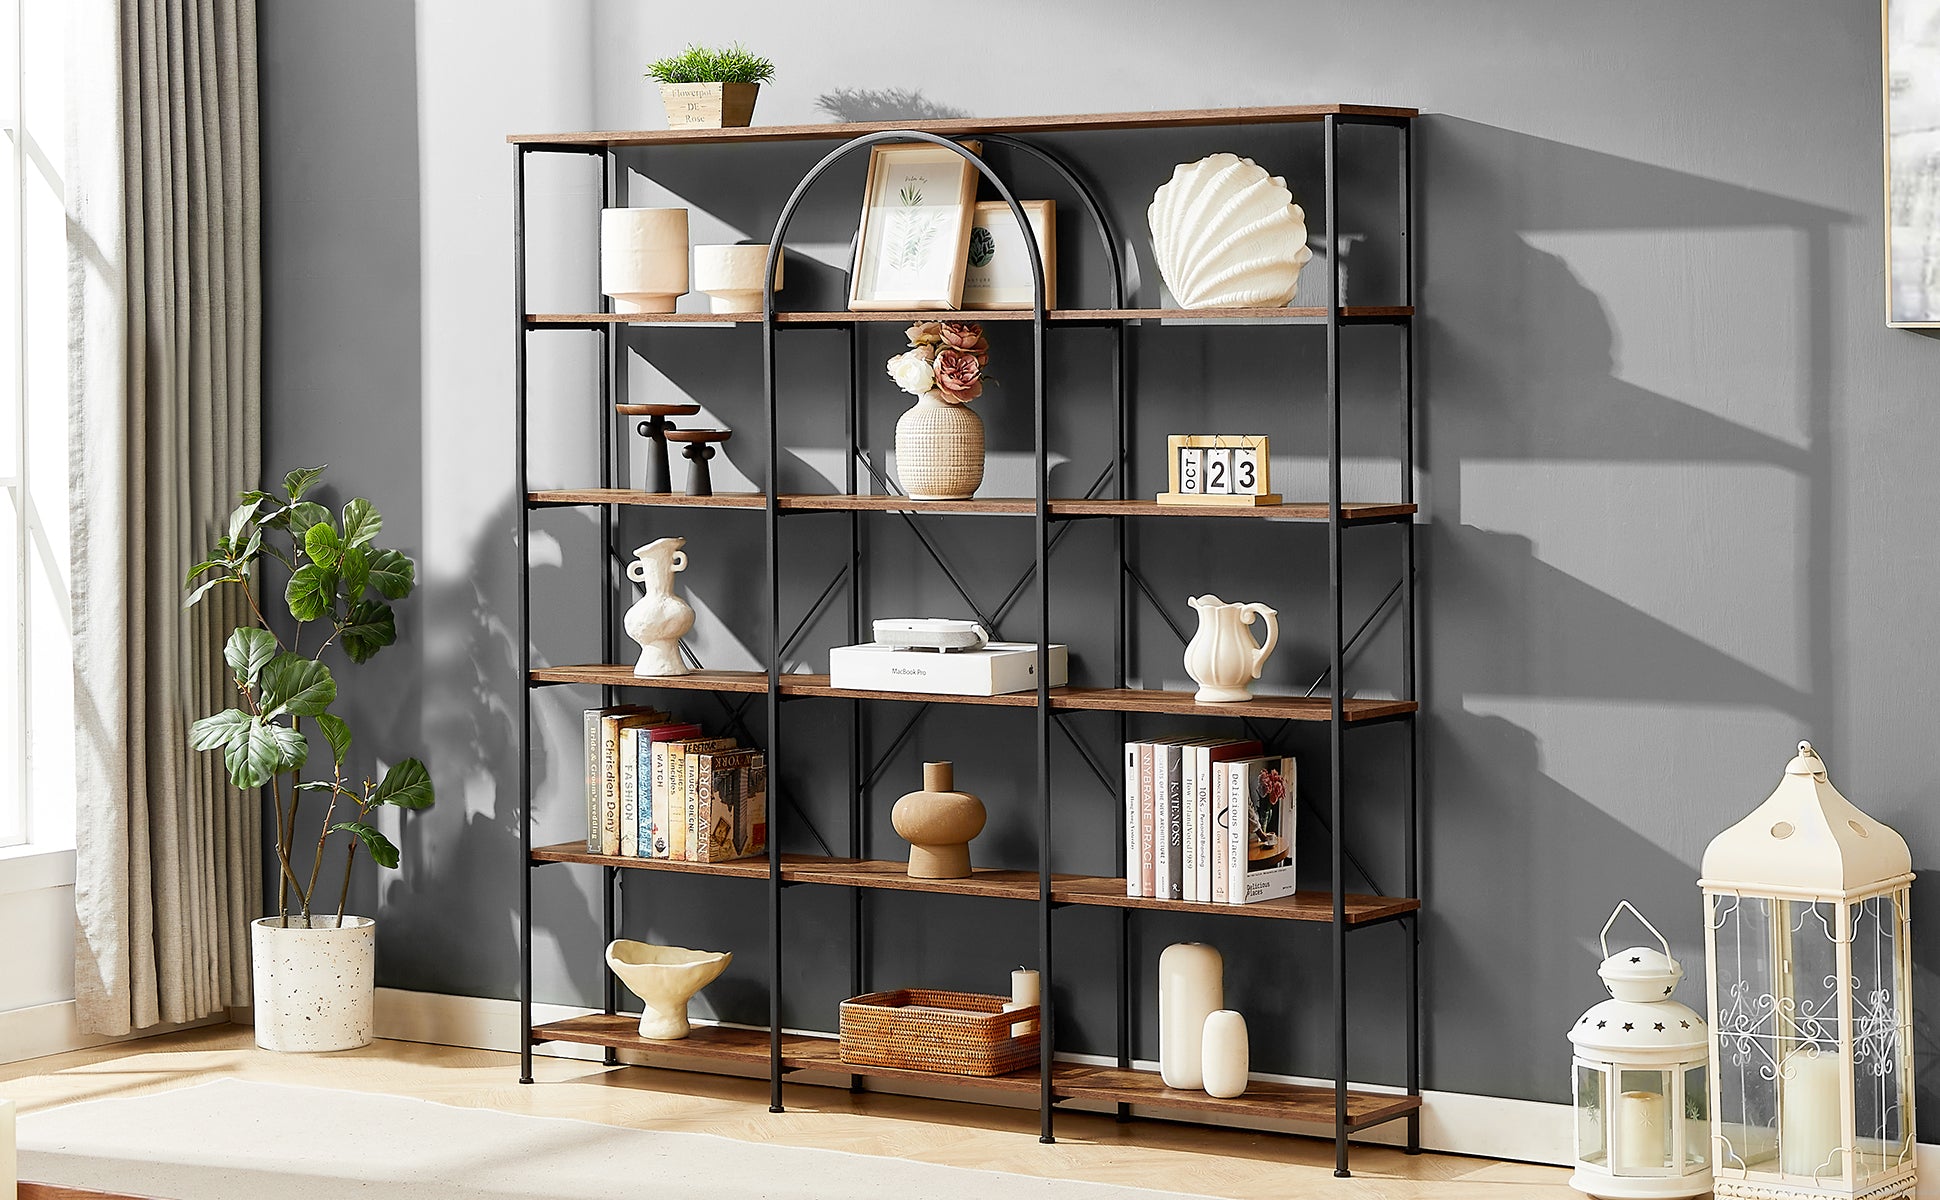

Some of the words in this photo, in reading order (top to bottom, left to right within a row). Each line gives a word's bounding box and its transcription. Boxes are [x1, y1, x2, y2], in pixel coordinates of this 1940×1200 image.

[672, 89, 712, 98] Flowerpot
[687, 102, 700, 111] DE
[685, 114, 705, 123] Rose
[1185, 458, 1196, 489] OCT
[590, 753, 597, 761] &
[605, 740, 616, 798] Chrisdien
[625, 765, 633, 821] FASHION
[700, 763, 709, 808] YORK
[1143, 752, 1152, 820] WYBRANE
[1231, 773, 1239, 827] Delicious
[605, 801, 616, 833] Deny
[698, 815, 708, 854] NEW
[1143, 825, 1152, 870] PRACE
[1231, 832, 1239, 869] Places
